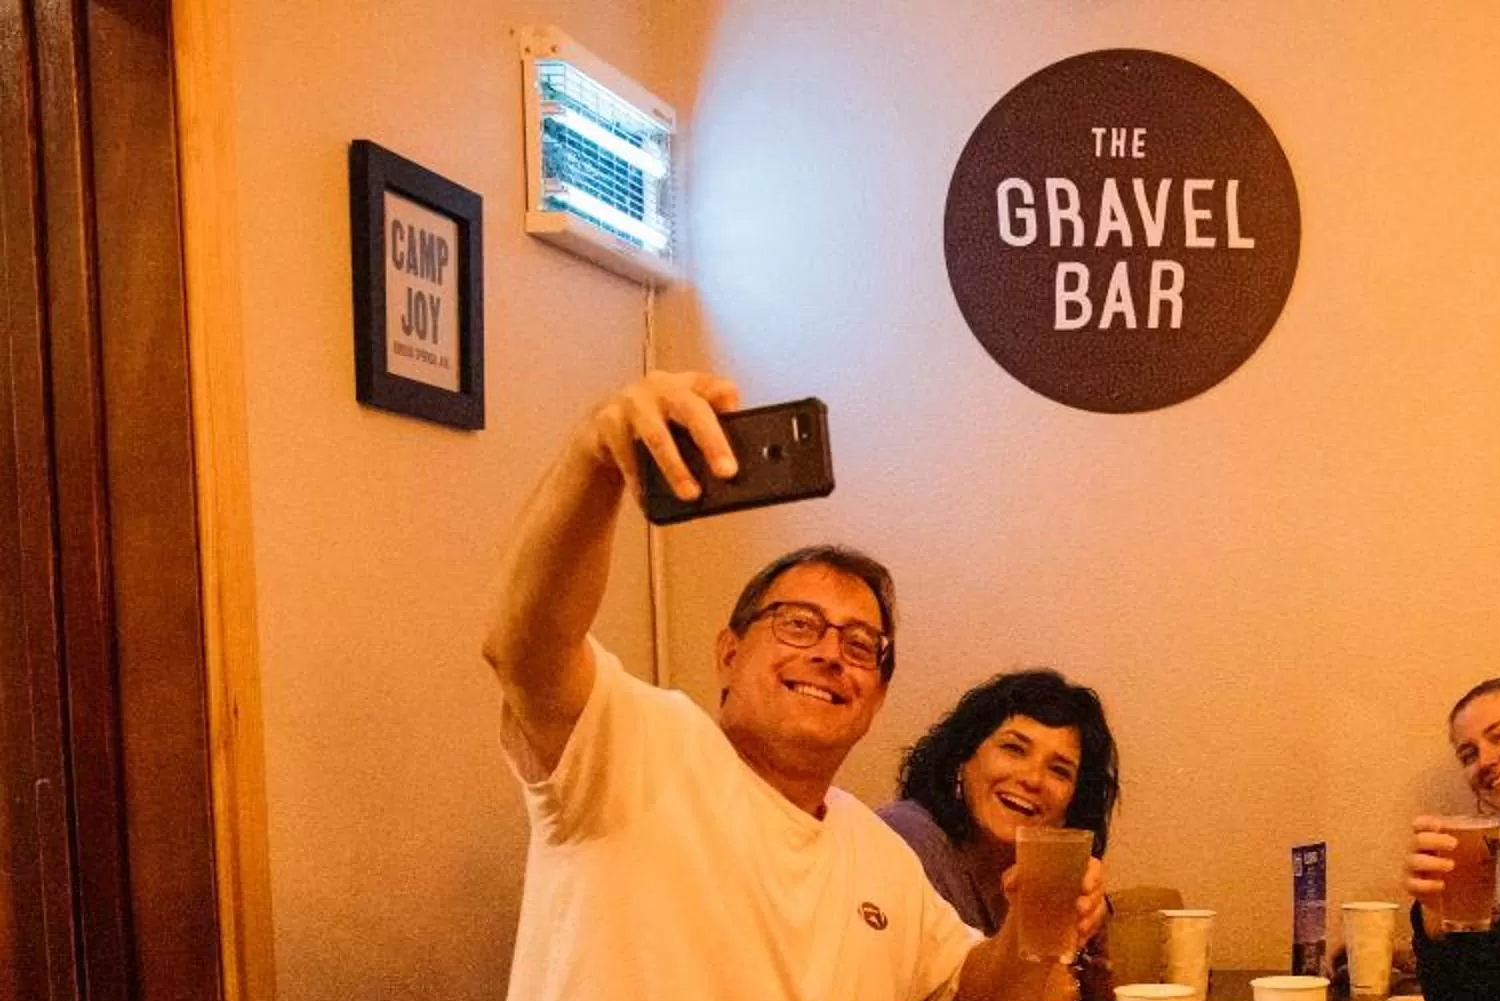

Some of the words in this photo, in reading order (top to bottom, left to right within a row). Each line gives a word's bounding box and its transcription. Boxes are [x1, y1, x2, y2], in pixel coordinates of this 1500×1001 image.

[1091, 127, 1147, 158] THE
[996, 177, 1255, 249] GRAVEL
[391, 219, 449, 286] CAMP
[401, 286, 441, 345] JOY
[1053, 260, 1186, 331] BAR
